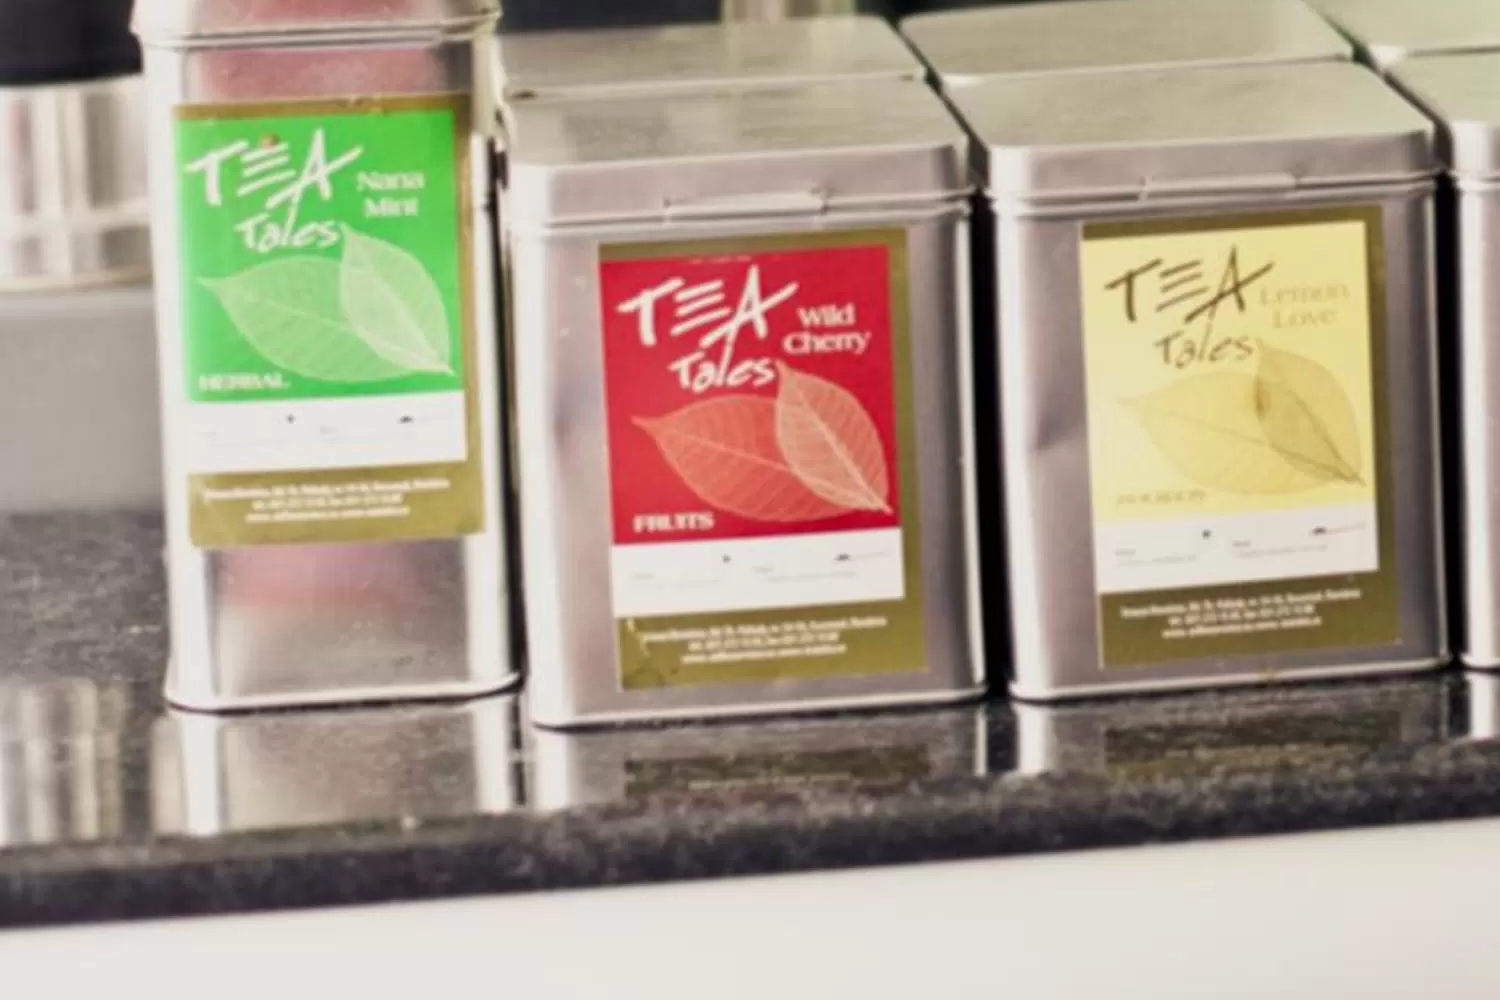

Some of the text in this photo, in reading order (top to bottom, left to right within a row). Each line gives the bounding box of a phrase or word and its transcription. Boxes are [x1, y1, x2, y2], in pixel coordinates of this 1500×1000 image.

[186, 128, 363, 209] TEA
[364, 197, 419, 218] Mint
[236, 206, 341, 251] Tales
[1105, 244, 1276, 324] TEA
[1259, 283, 1349, 306] Lemon
[617, 264, 798, 348] TEA
[796, 302, 856, 328] Wild
[1272, 309, 1338, 328] Love
[783, 330, 872, 355] Cherry
[1153, 326, 1255, 368] Tales
[669, 349, 775, 391] Tales
[632, 511, 714, 532] FRUITS
